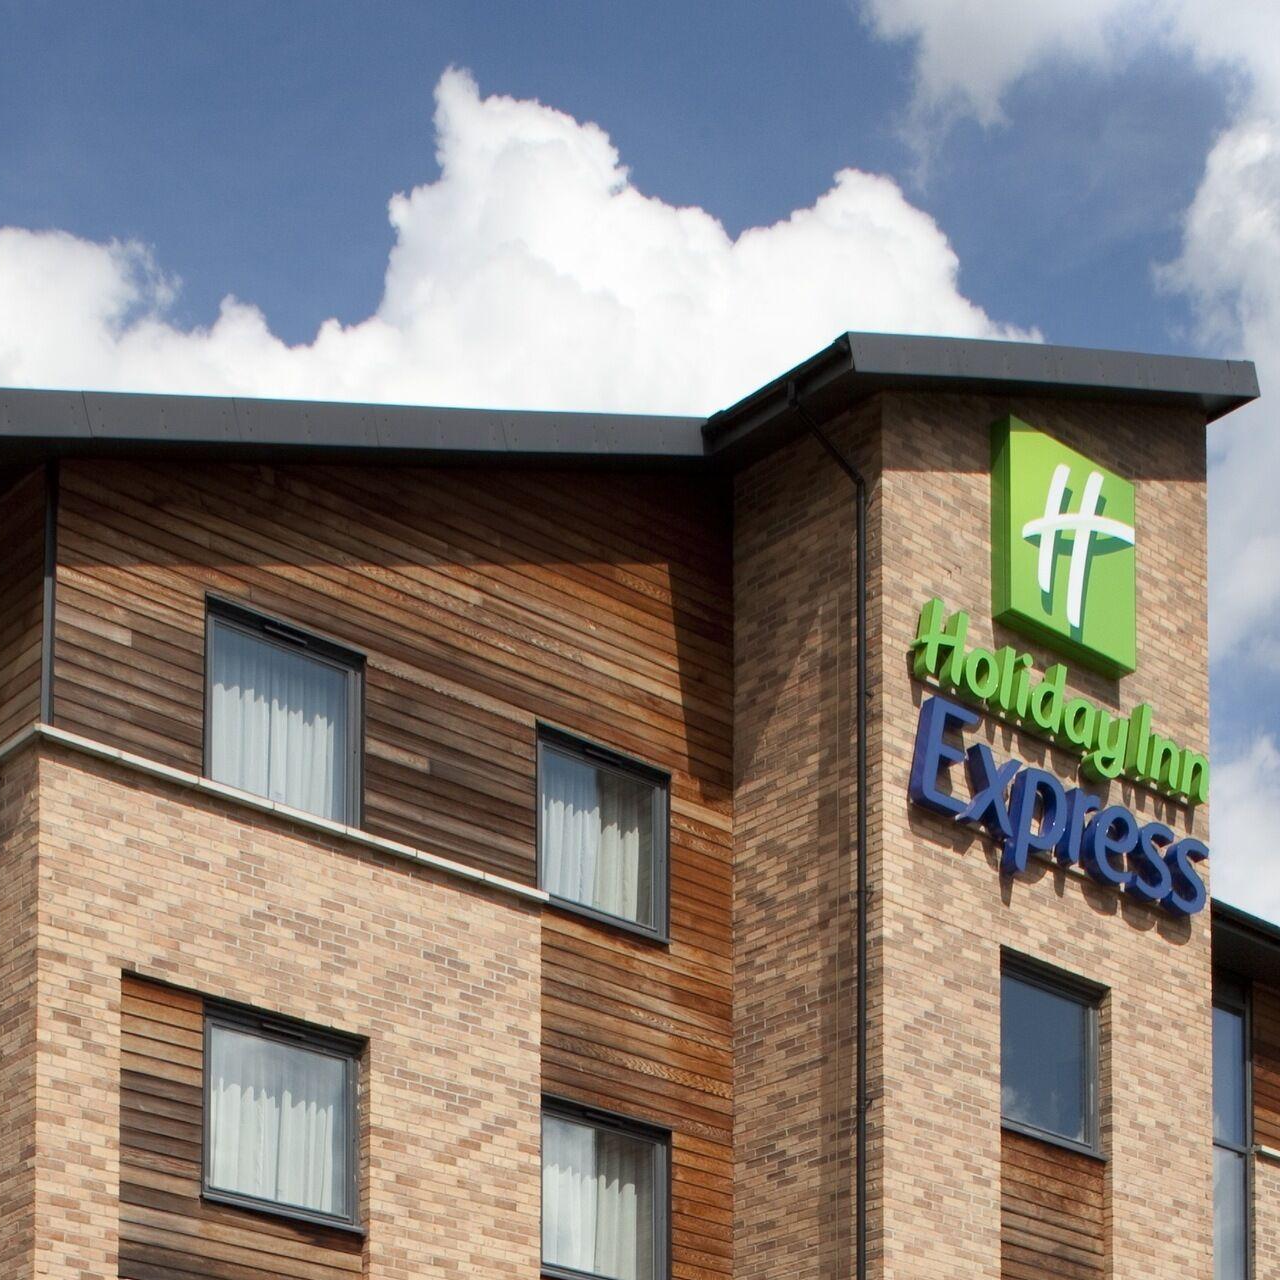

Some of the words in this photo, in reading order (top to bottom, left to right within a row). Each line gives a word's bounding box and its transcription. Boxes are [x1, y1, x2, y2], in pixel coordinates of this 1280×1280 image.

[909, 695, 1209, 916] Express
[910, 598, 1129, 780] Holiday
[1125, 702, 1209, 804] Inn
